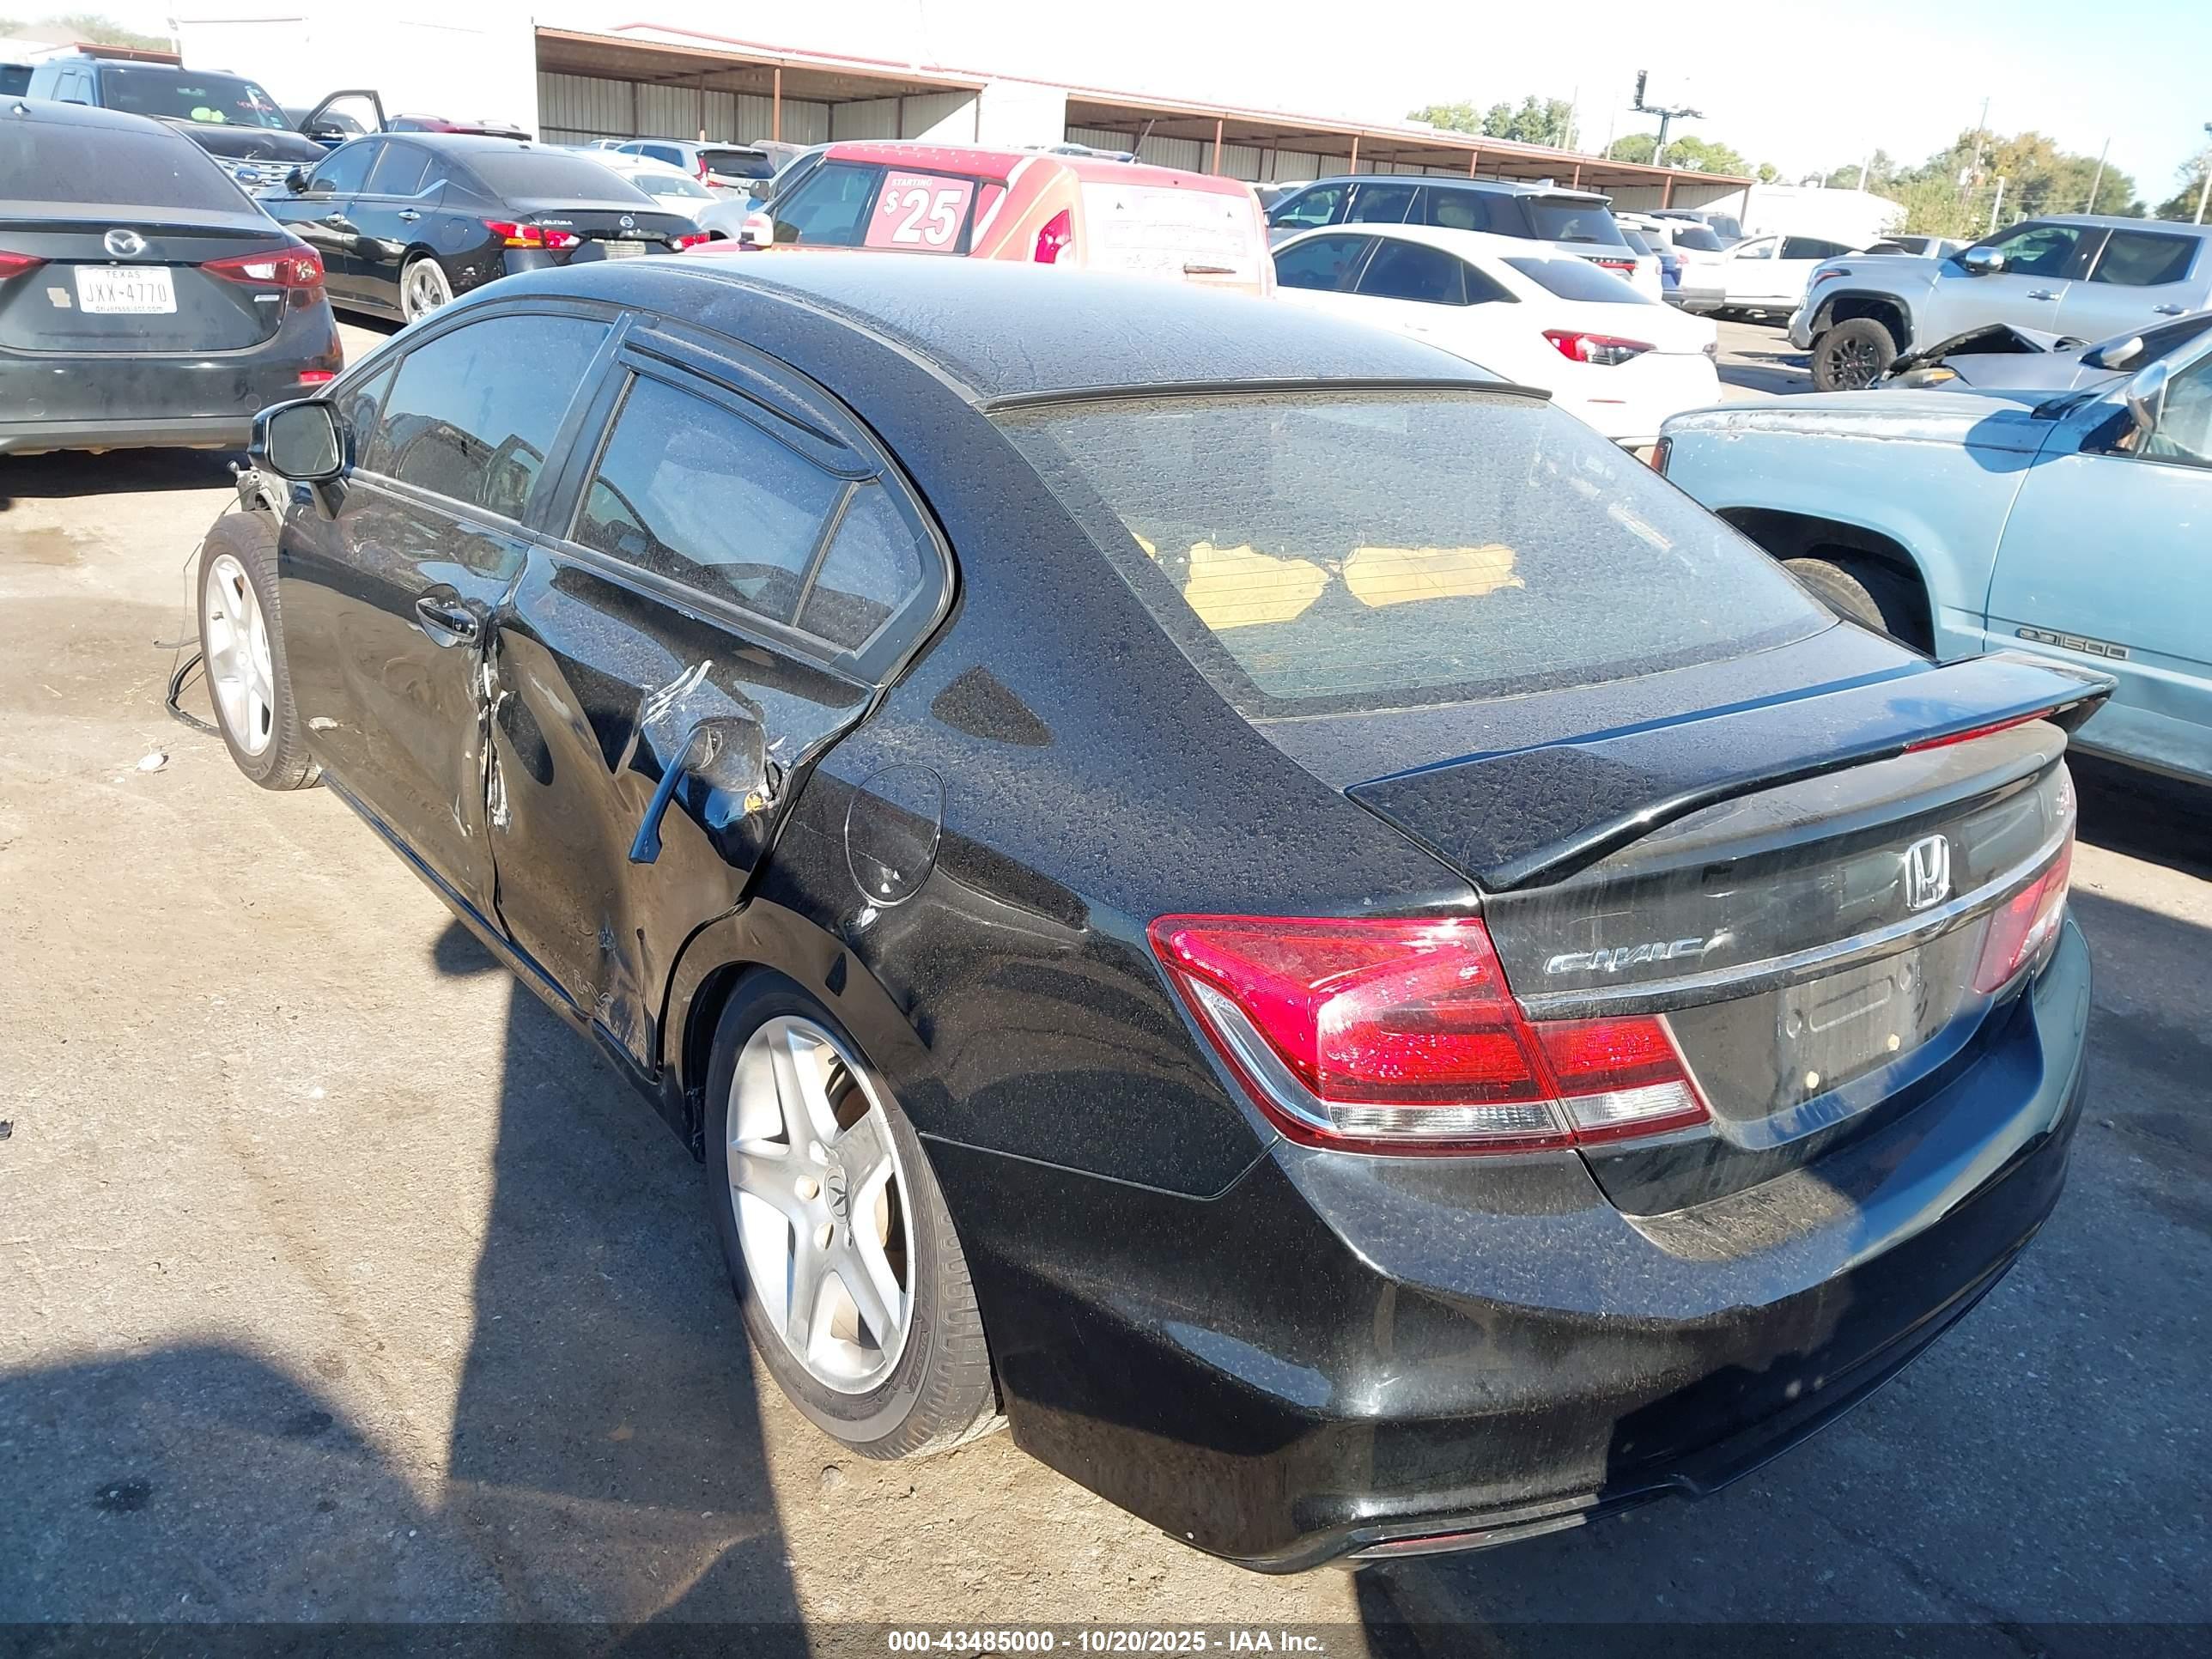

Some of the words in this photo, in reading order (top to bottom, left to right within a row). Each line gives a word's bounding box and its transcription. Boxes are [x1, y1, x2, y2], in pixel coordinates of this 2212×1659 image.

[891, 178, 933, 186] STARTING
[883, 188, 963, 246] $25
[86, 283, 167, 302] JXX-4770
[1543, 938, 1704, 974] CIVIC
